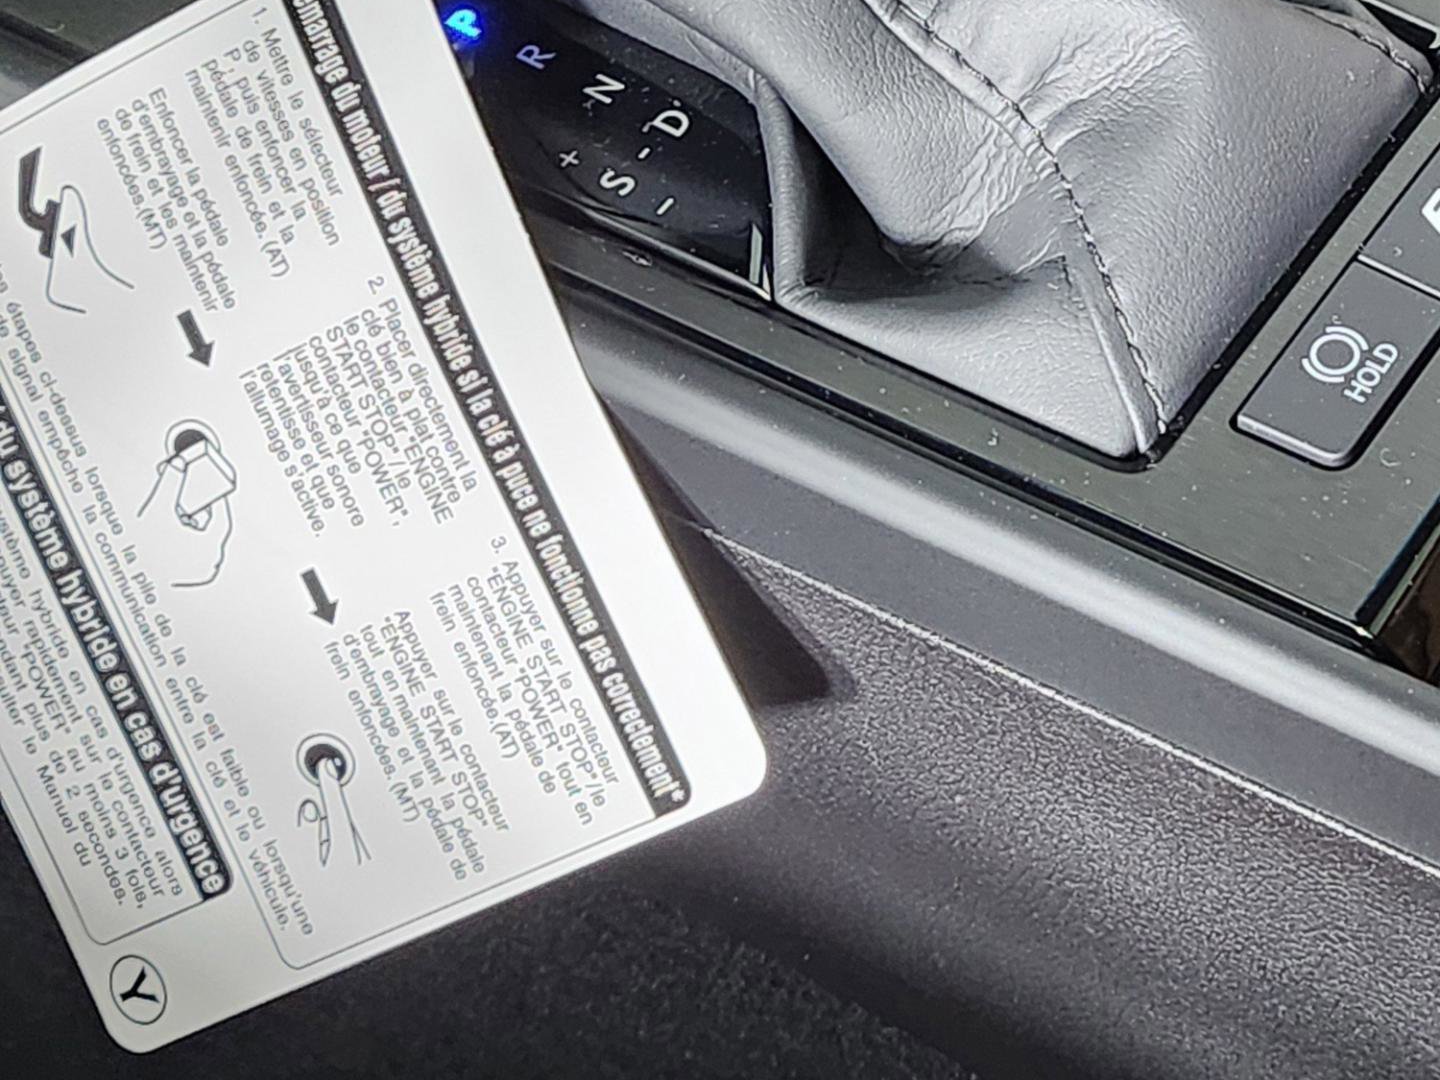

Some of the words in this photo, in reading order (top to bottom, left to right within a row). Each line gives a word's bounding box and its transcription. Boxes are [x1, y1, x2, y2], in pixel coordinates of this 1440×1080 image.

[242, 39, 261, 64] de
[444, 9, 482, 39] P
[516, 44, 556, 70] R
[185, 68, 232, 149] maintenir
[256, 68, 295, 143] vitesses
[260, 27, 294, 86] Mettre
[287, 90, 304, 111] le
[298, 117, 343, 197] sélecteur
[331, 82, 362, 113] du
[582, 73, 625, 105] N
[148, 87, 194, 165] Enfoncer
[200, 58, 239, 119] pédale
[235, 125, 253, 150] de
[246, 152, 273, 195] frein
[268, 201, 286, 221] et
[278, 224, 295, 245] la
[229, 76, 260, 115] puis
[255, 119, 297, 194] enfoncer
[290, 199, 307, 222] la
[342, 108, 390, 179] moteur
[651, 109, 690, 138] D
[185, 166, 201, 187] la
[289, 147, 307, 172] en
[600, 169, 636, 196] S
[115, 108, 133, 132] de
[125, 132, 152, 174] frein
[146, 178, 165, 198] et
[158, 201, 178, 230] les
[172, 233, 218, 312] maintenir
[183, 211, 201, 231] et
[190, 187, 229, 247] pédale
[297, 177, 340, 247] position
[376, 190, 407, 220] du
[191, 229, 208, 250] la
[386, 216, 440, 299] système
[197, 250, 236, 310] pédale
[360, 308, 386, 338] clé
[422, 294, 473, 371] hybride
[308, 335, 363, 428] contacteur
[342, 315, 360, 337] le
[353, 338, 409, 434] contacteur
[376, 340, 404, 385] bien
[456, 369, 488, 393] si
[1344, 342, 1399, 403] HOLD
[256, 362, 306, 451] retentisse
[326, 325, 370, 389] START
[394, 468, 412, 490] le
[378, 297, 417, 359] Placer
[407, 362, 471, 472] directement
[459, 470, 477, 493] la
[397, 388, 415, 404] à
[466, 388, 494, 416] la
[324, 412, 344, 436] ce
[335, 438, 362, 475] que
[402, 407, 435, 447] plat
[477, 414, 515, 447] clé
[492, 443, 520, 463] à
[300, 453, 320, 473] et
[309, 474, 336, 510] que
[425, 445, 461, 504] contre
[495, 461, 539, 511] puce
[326, 464, 365, 527] sonore
[522, 509, 552, 537] ne
[6, 301, 42, 364] étapes
[39, 371, 87, 458] ci-dessus
[84, 466, 124, 536] lorsque
[121, 544, 137, 565] la
[130, 571, 157, 605] pile
[154, 613, 173, 638] de
[185, 676, 209, 704] clé
[202, 712, 225, 742] est
[219, 748, 250, 798] faible
[4, 460, 69, 570] système
[56, 569, 118, 672] hybride
[105, 673, 138, 710] en
[124, 712, 162, 761] cas
[429, 591, 457, 633] frein
[535, 534, 599, 636] fonctionne
[7, 348, 44, 403] signal
[37, 410, 84, 494] empêche
[165, 677, 195, 724] entre
[205, 760, 228, 789] clé
[248, 849, 289, 932] véhicule.
[324, 641, 351, 681] frein
[359, 624, 386, 659] tout
[447, 583, 505, 681] maintenant
[578, 634, 617, 673] pas
[381, 669, 400, 692] en
[466, 576, 519, 665] contacteur
[555, 761, 583, 798] tout
[574, 801, 593, 826] en
[496, 682, 513, 703] la
[501, 561, 547, 632] Appuyer
[540, 638, 563, 666] sur
[556, 670, 573, 690] le
[569, 697, 620, 784] contacteur
[526, 654, 568, 714] START
[392, 693, 447, 786] maintenant
[393, 611, 438, 679] Appuyer
[433, 689, 456, 716] sur
[447, 717, 463, 737] le
[459, 743, 510, 831] contacteur
[419, 704, 459, 762] START
[504, 708, 544, 768] pédale
[440, 791, 456, 812] la
[537, 770, 556, 794] de
[397, 746, 415, 766] et
[408, 770, 425, 790] la
[417, 796, 455, 854] pédale
[449, 858, 467, 881] de
[447, 816, 485, 874] pédale
[119, 966, 159, 1003] Y
